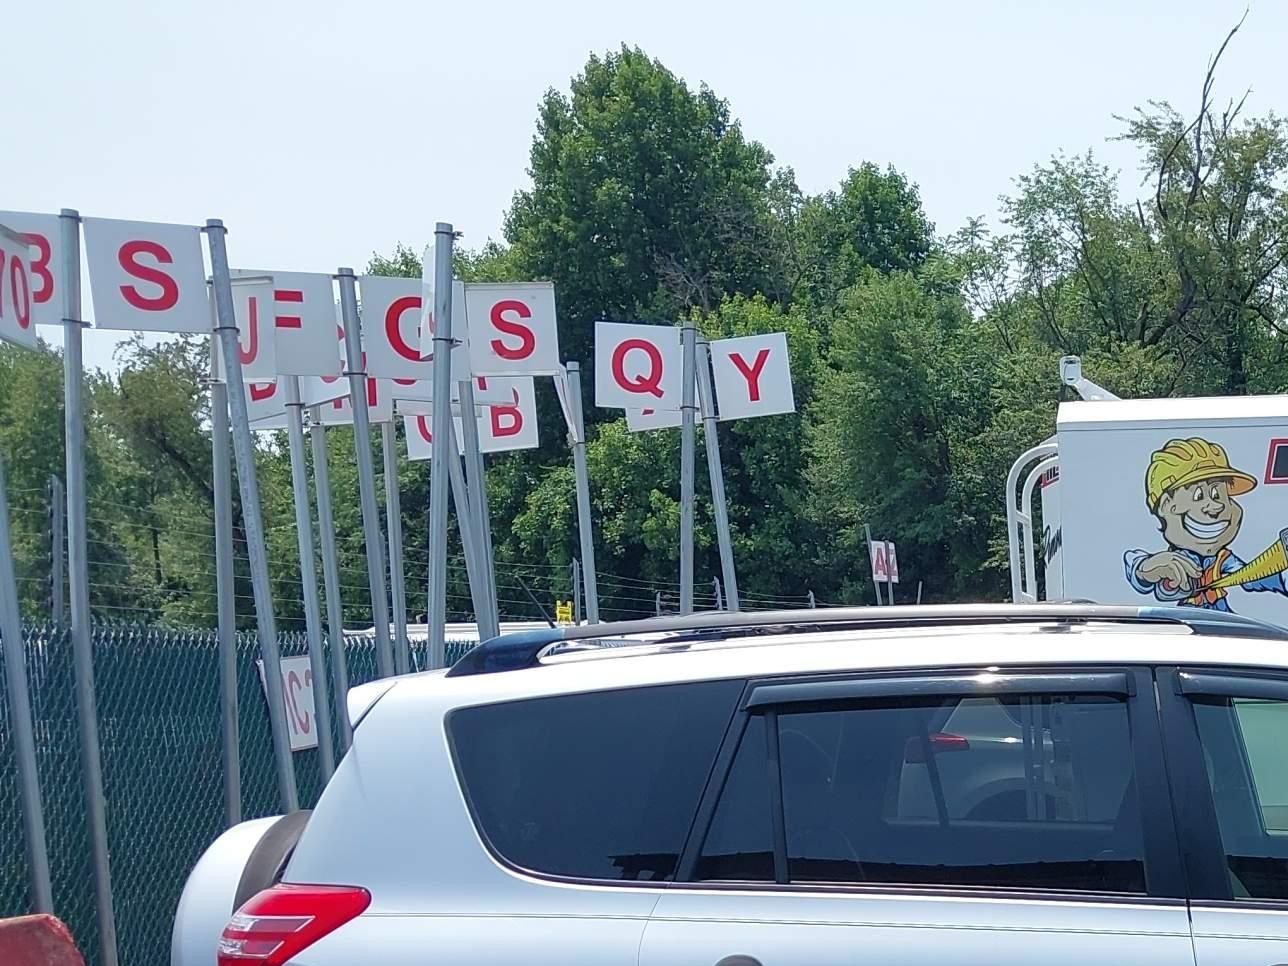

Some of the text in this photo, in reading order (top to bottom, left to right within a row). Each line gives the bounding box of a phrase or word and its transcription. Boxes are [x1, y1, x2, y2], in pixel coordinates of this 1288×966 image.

[118, 240, 179, 311] S
[490, 299, 536, 361] S
[611, 338, 664, 399] Q
[728, 349, 771, 402] Y
